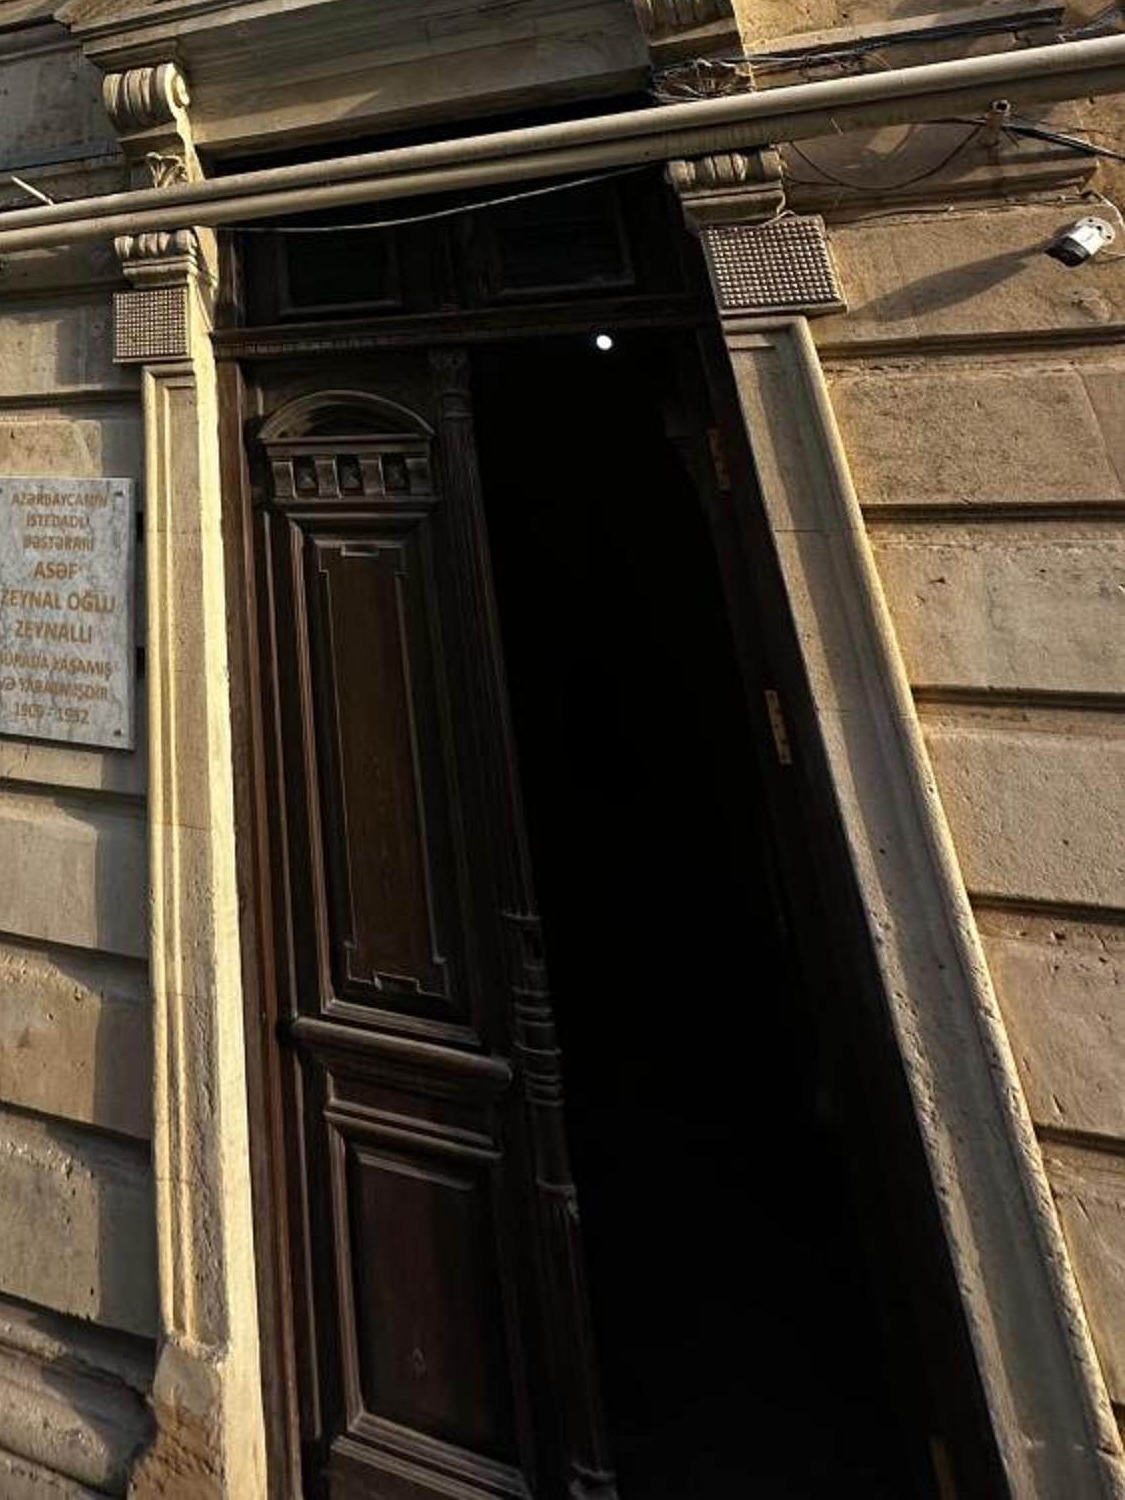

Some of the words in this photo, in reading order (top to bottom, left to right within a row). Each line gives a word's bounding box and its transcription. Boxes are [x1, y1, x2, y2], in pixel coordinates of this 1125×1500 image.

[34, 561, 78, 580] ASƏF
[1, 589, 61, 610] ZEYNAL
[66, 590, 116, 612] OĞLU
[15, 619, 91, 644] ZEYNALLI
